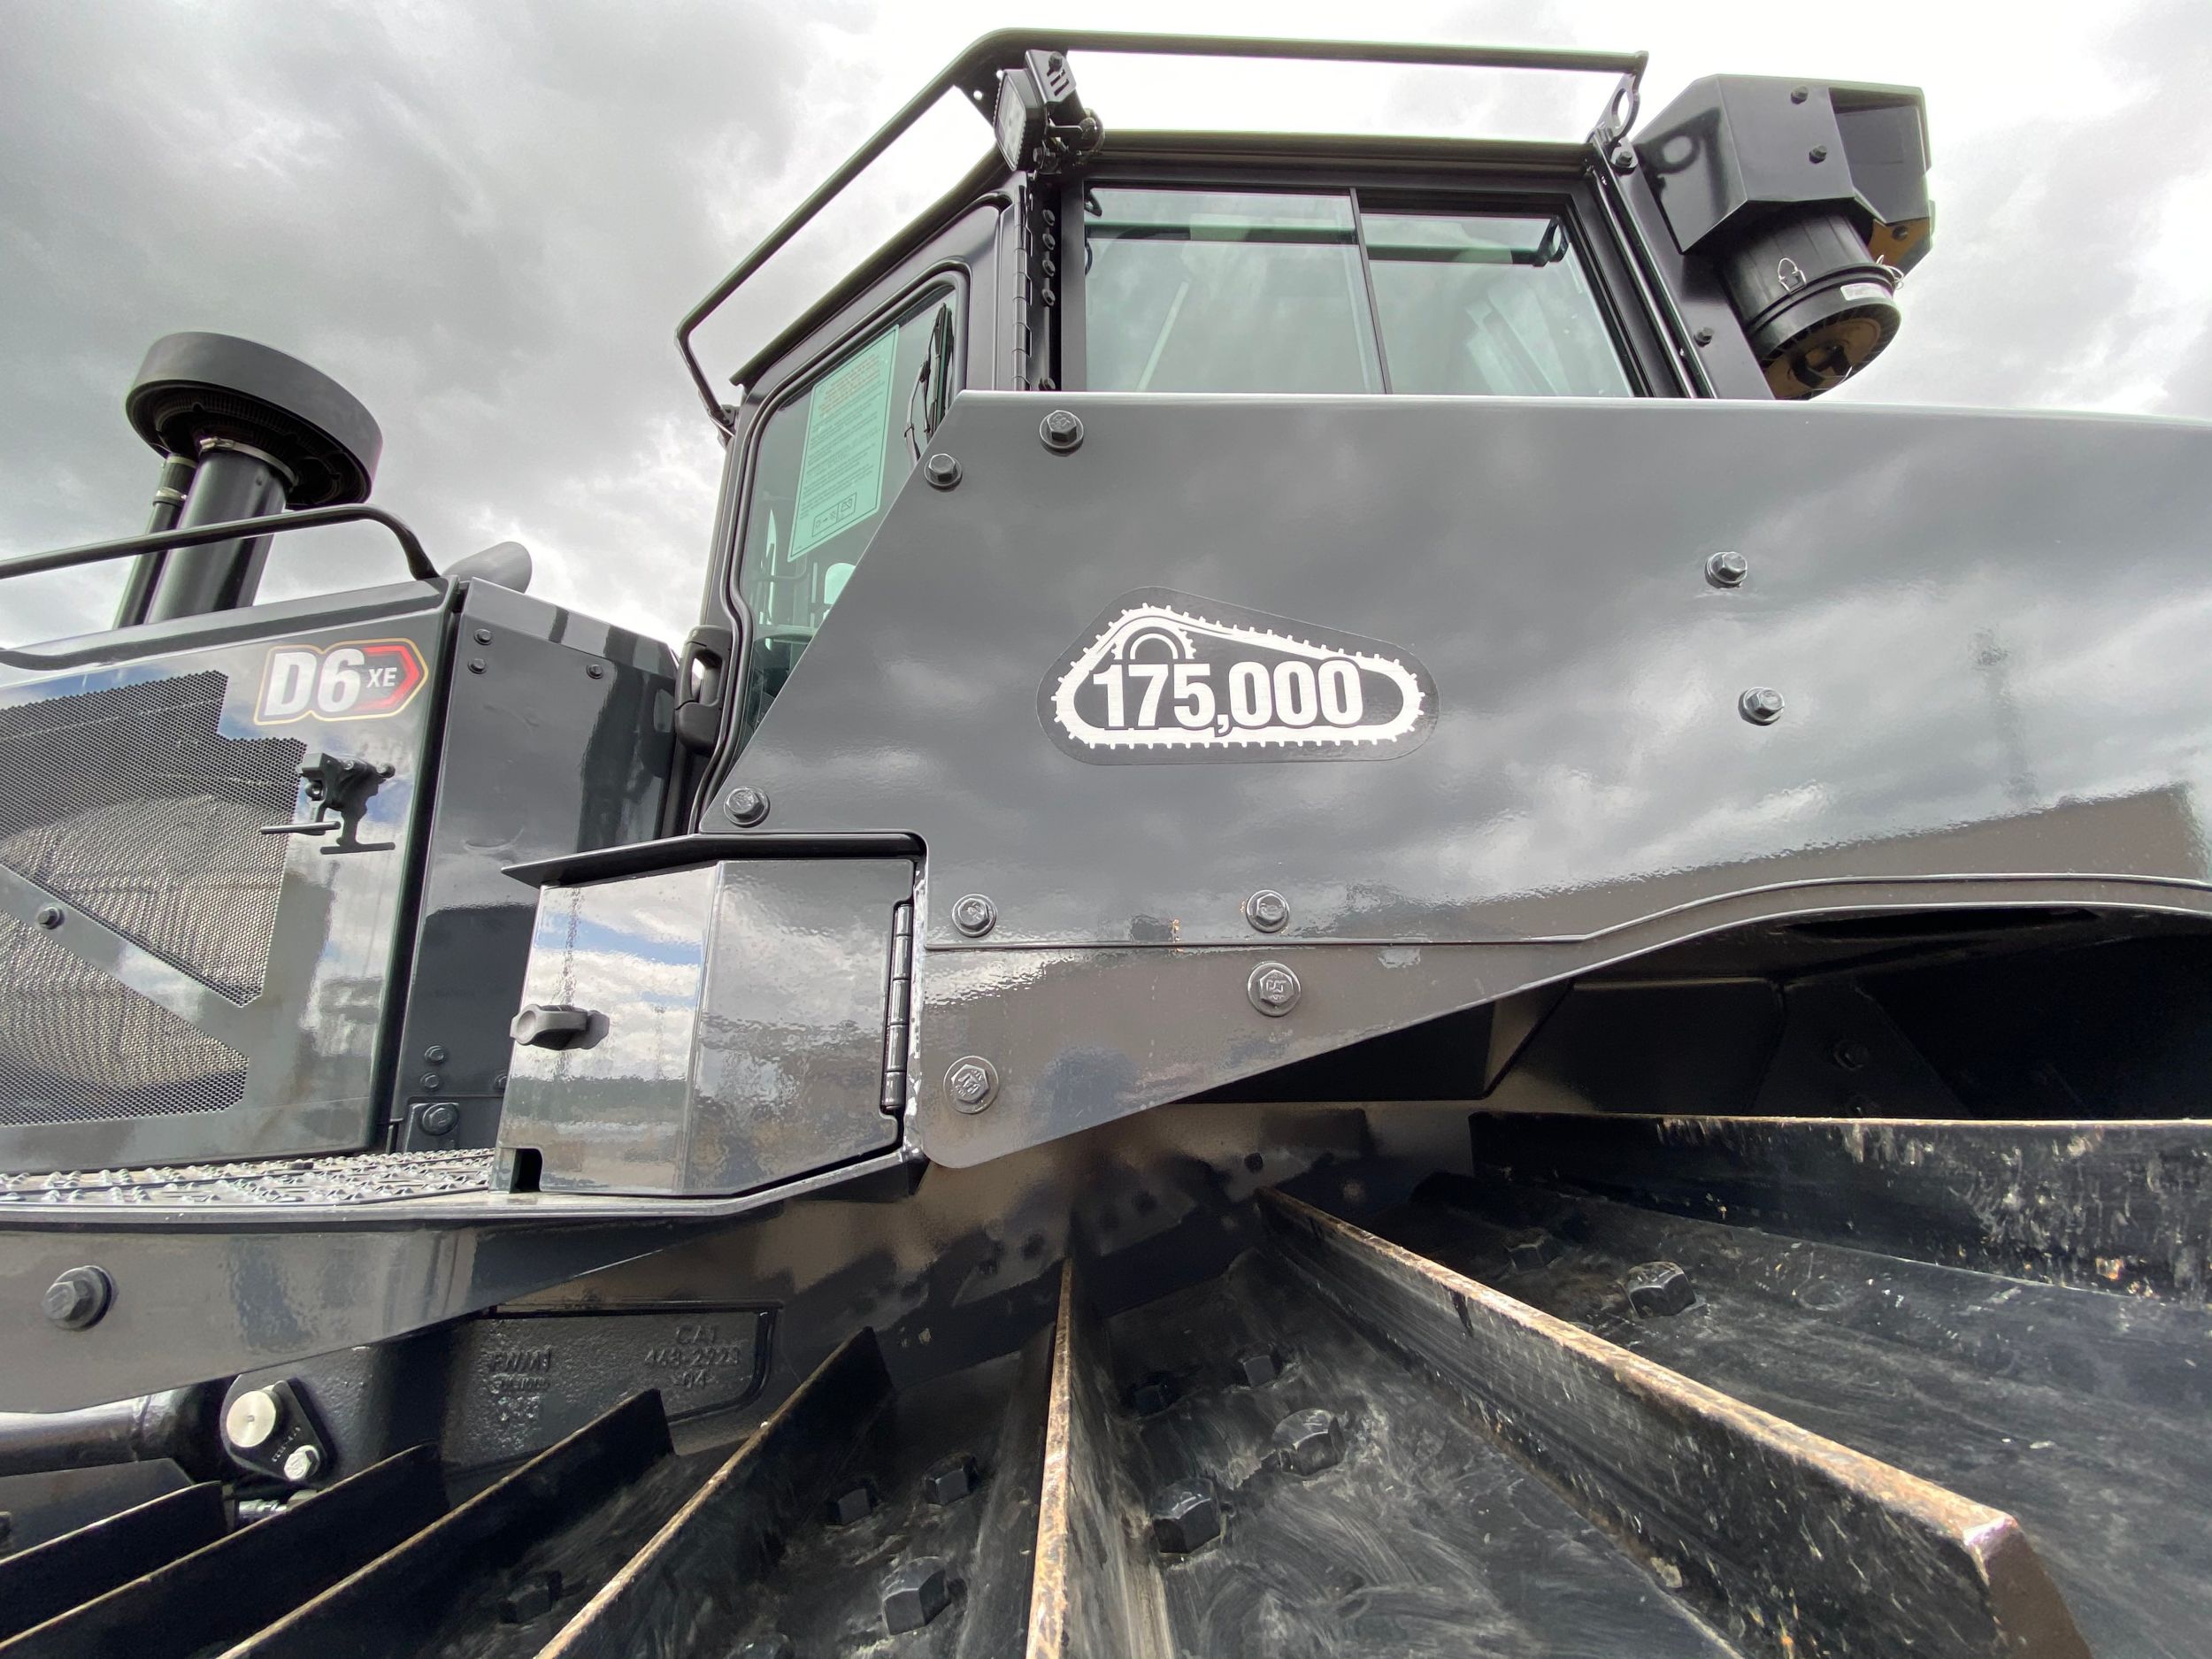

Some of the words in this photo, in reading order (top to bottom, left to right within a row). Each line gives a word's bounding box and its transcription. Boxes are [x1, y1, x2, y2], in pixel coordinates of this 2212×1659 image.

[265, 648, 365, 716] D6
[366, 667, 397, 687] XE
[1093, 660, 1363, 734] 175,000
